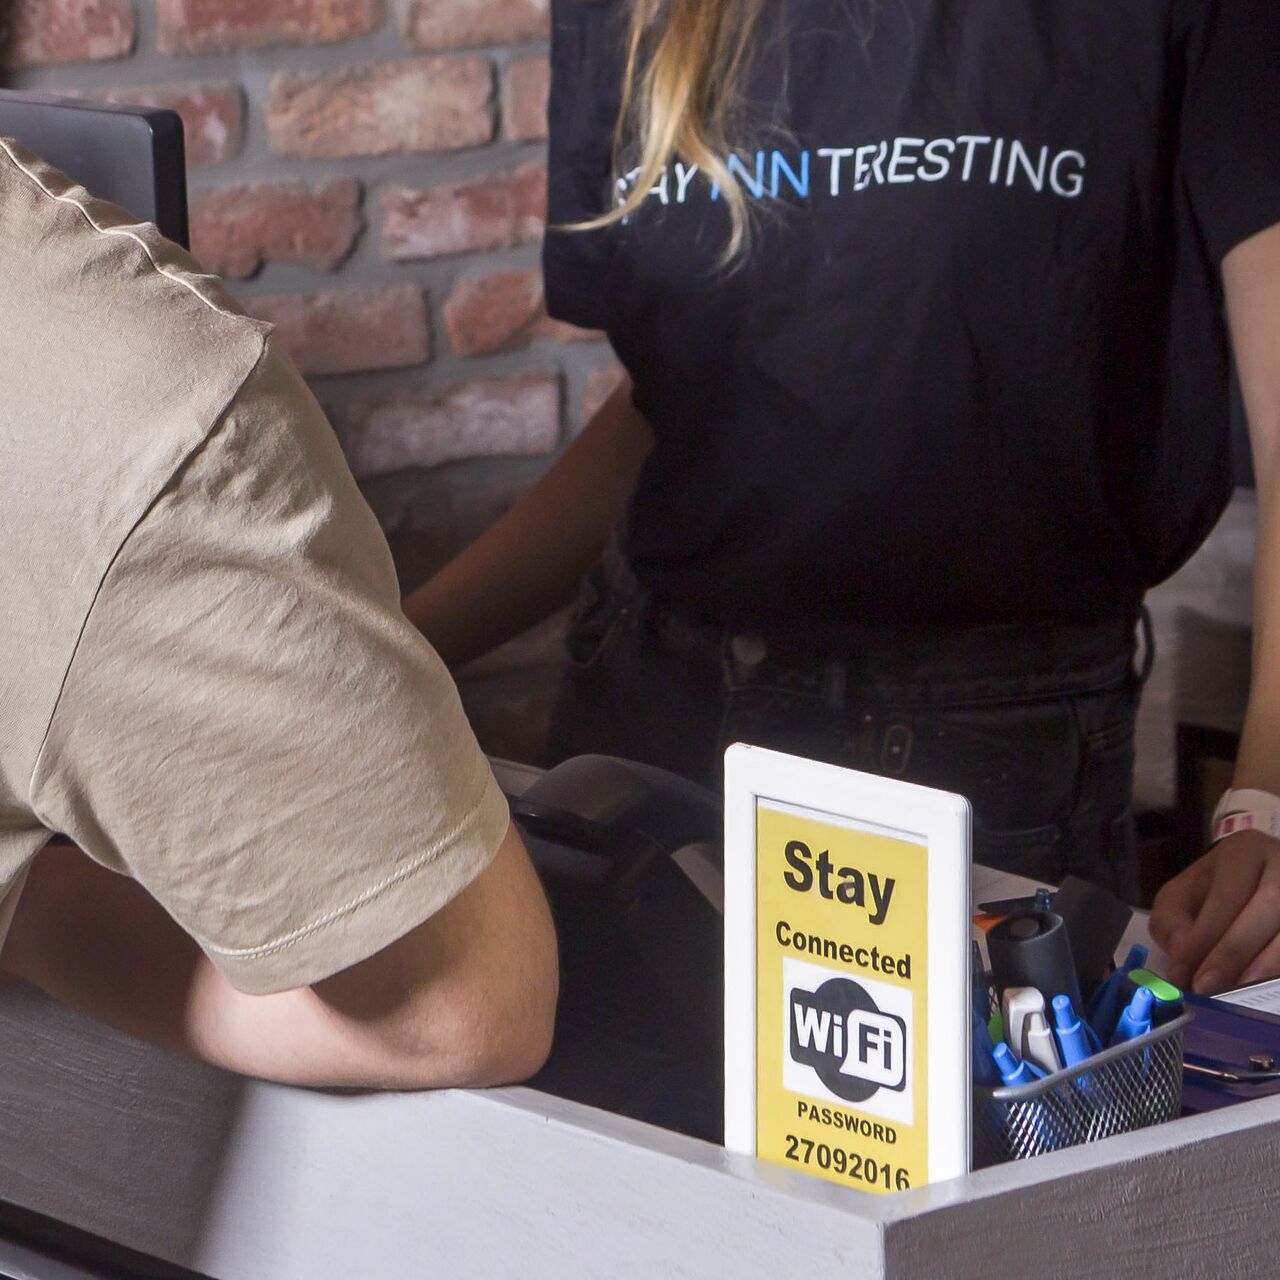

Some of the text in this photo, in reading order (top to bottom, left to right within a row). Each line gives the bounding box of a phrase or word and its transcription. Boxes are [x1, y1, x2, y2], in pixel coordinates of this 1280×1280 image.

[783, 839, 896, 926] Stay
[775, 920, 912, 980] Connected
[797, 1101, 897, 1146] PASSWORD
[785, 1134, 912, 1192] 27092016
